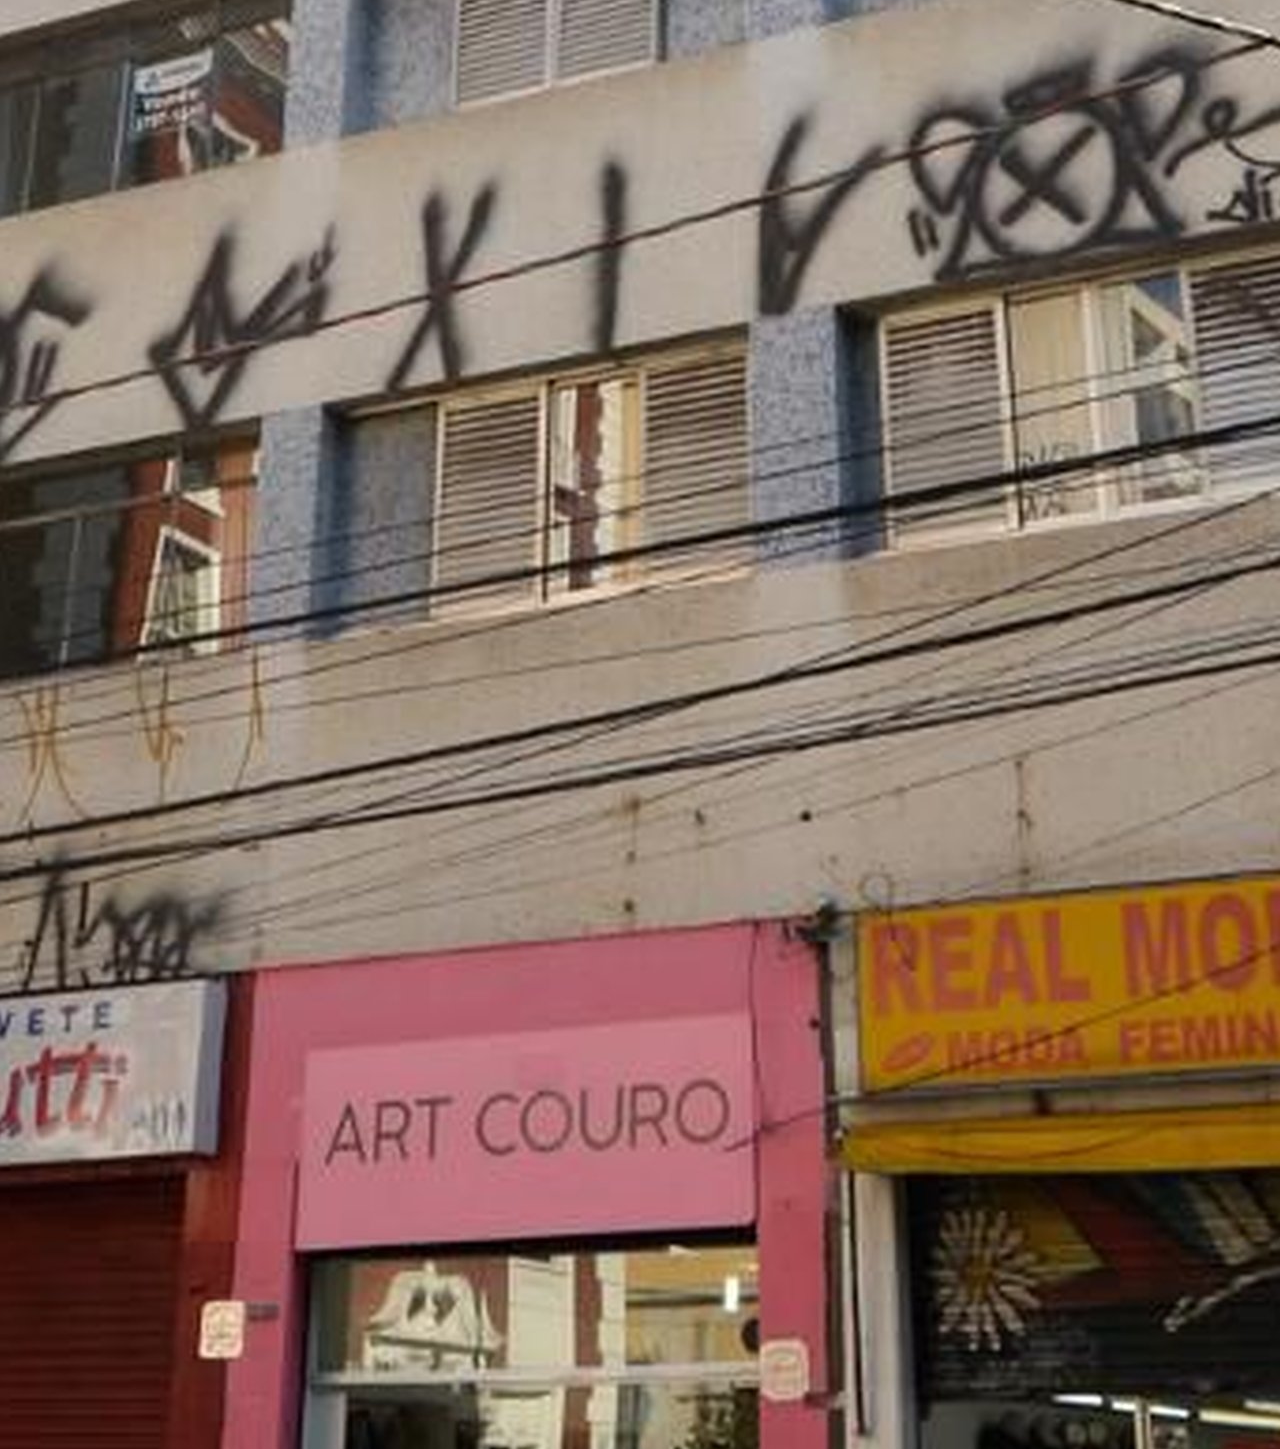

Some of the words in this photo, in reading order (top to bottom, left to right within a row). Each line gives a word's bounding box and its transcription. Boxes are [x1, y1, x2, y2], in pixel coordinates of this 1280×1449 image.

[870, 907, 1093, 1018] REAL
[946, 1025, 1089, 1072] MODA
[323, 1097, 454, 1168] ART
[474, 1078, 732, 1157] COURO
